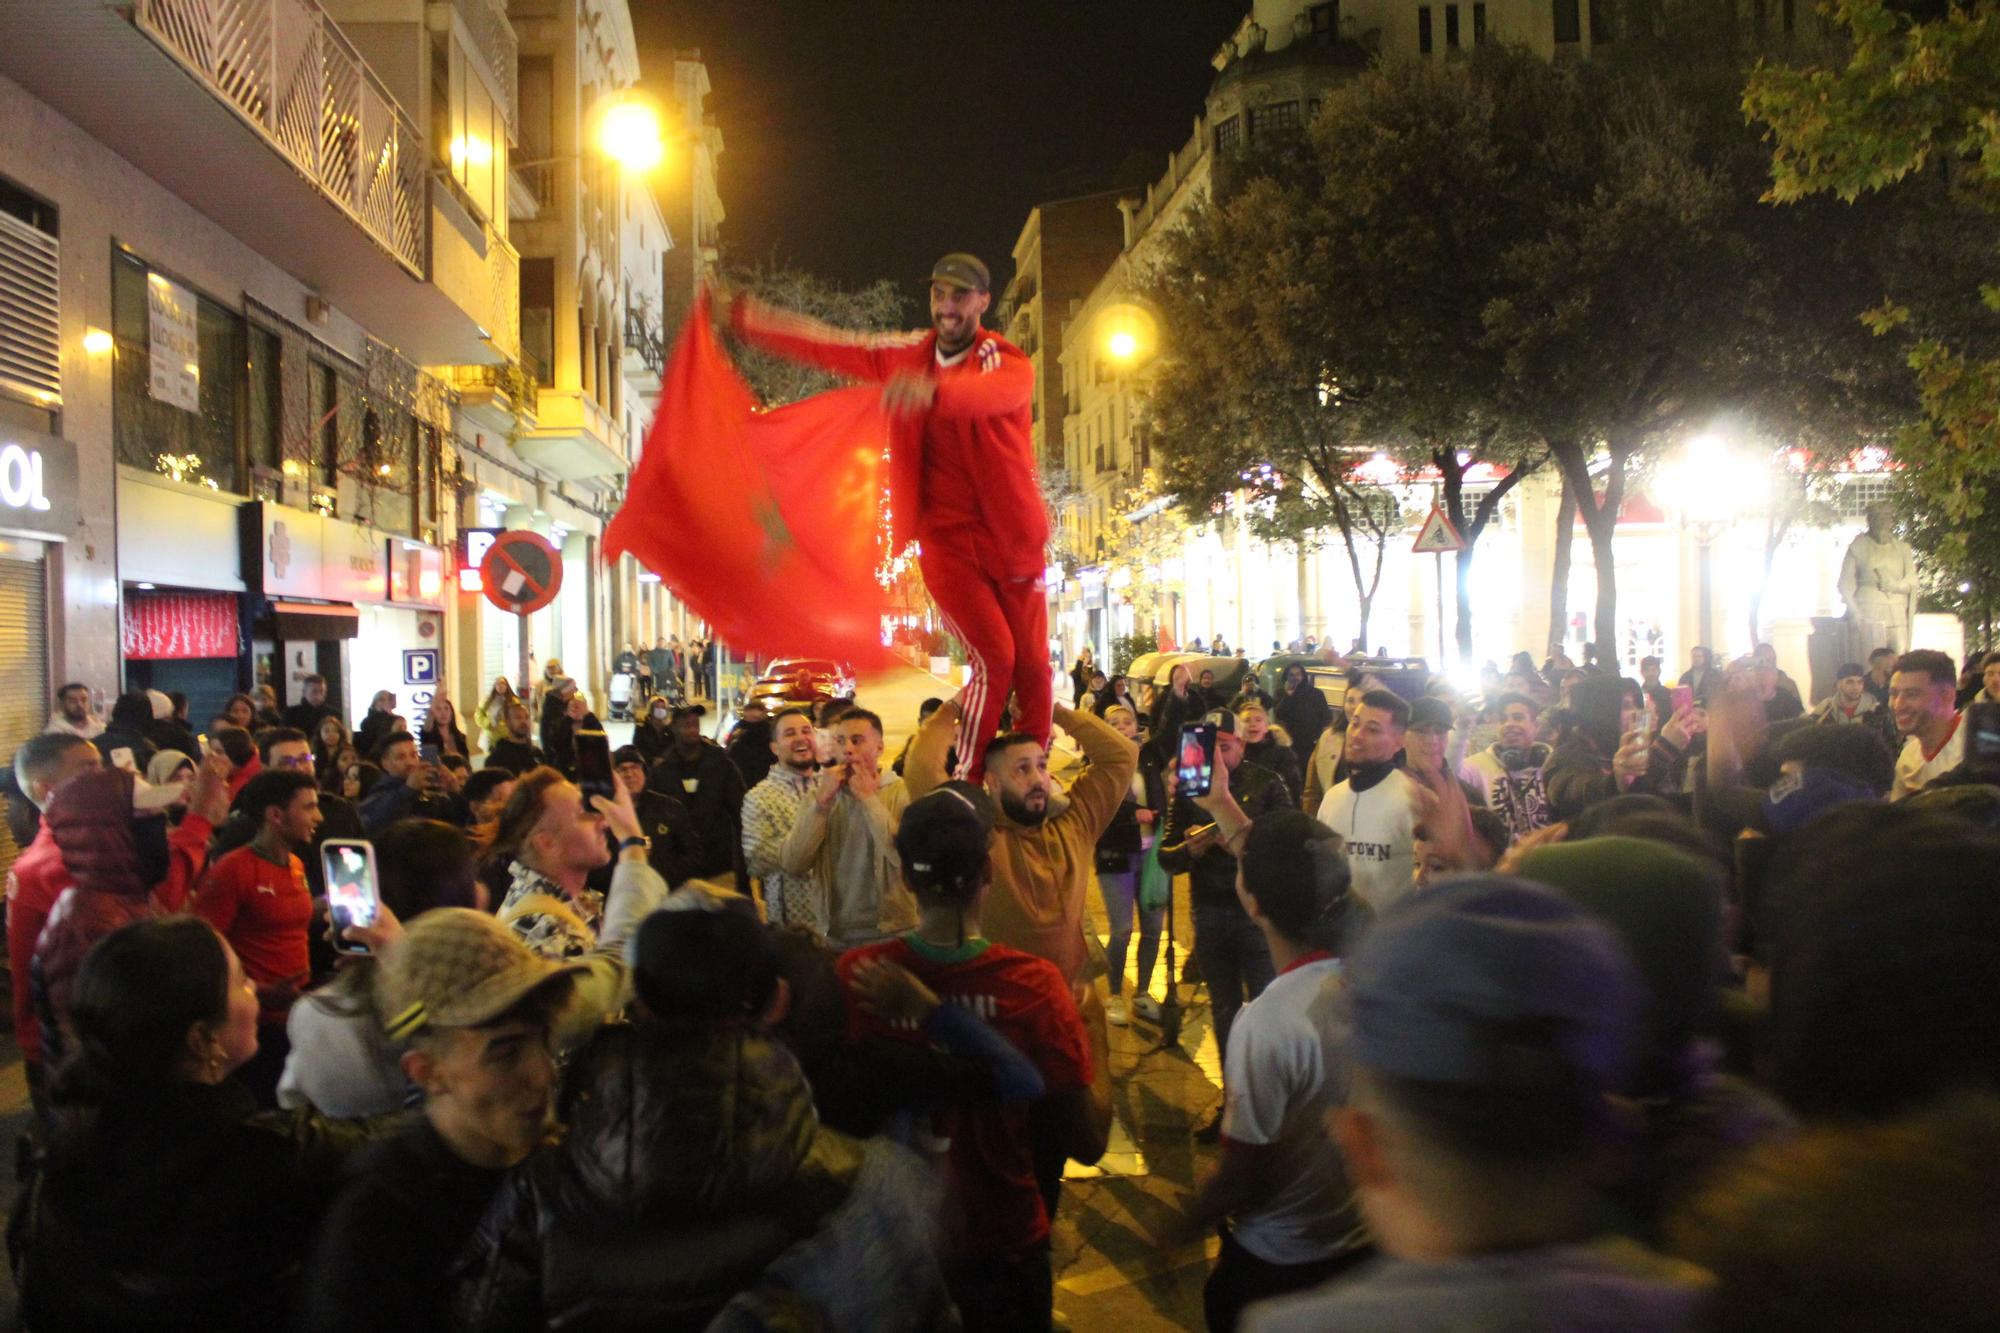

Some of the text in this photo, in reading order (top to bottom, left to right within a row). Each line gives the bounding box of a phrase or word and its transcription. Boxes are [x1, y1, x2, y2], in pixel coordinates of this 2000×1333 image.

[468, 531, 496, 568] P
[411, 655, 431, 679] P
[1345, 842, 1391, 862] TOWN
